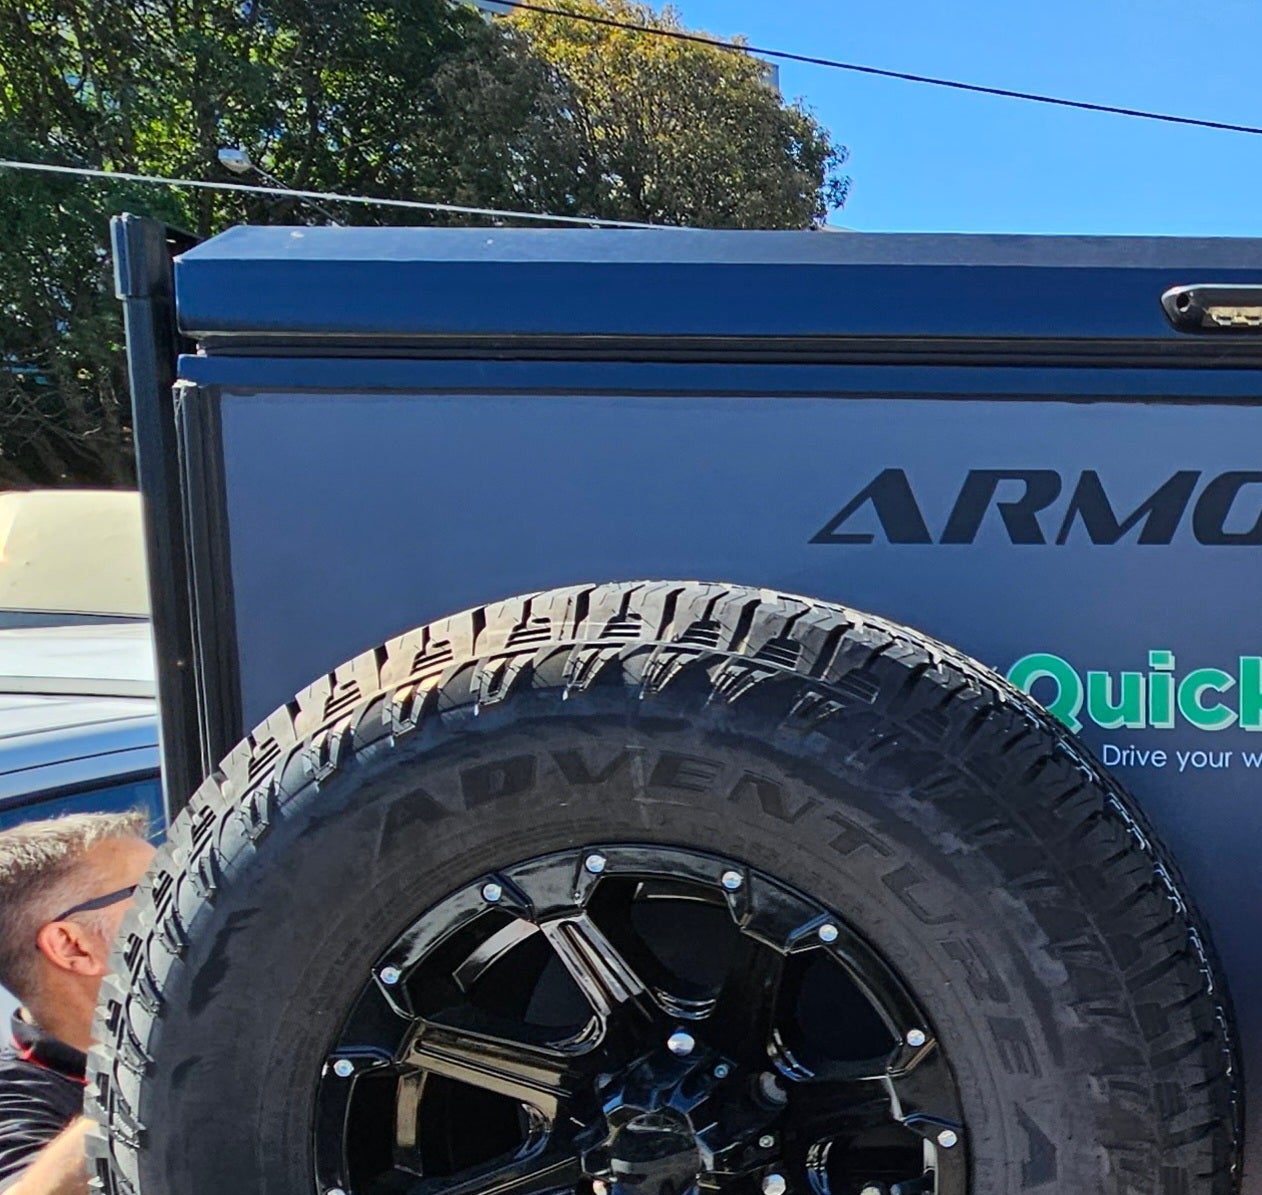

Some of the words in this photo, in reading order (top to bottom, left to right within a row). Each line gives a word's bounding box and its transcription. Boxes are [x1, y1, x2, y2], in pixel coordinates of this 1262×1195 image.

[1102, 744, 1167, 768] Drive
[1176, 750, 1233, 773] your
[375, 746, 1042, 1076] ADVENTURE
